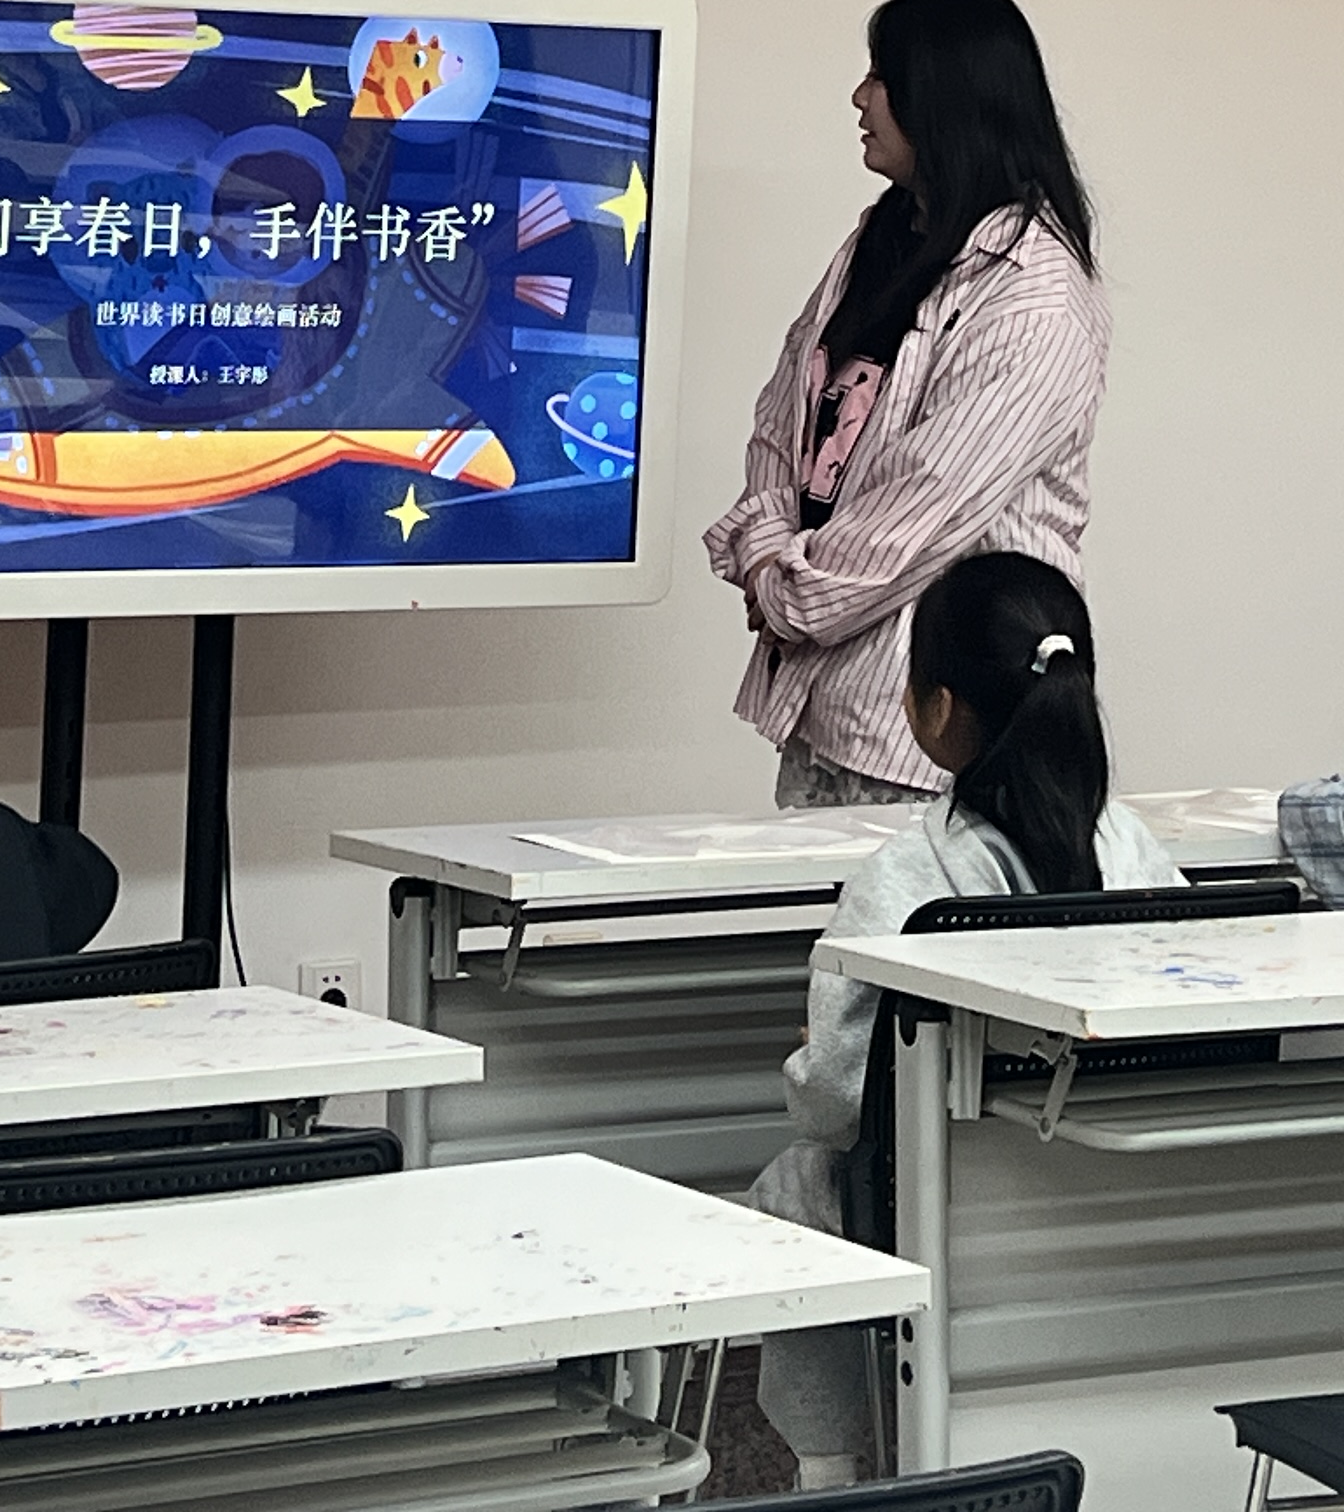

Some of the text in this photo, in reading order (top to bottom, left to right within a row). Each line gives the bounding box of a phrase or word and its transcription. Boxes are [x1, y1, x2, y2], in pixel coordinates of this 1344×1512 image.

[95, 299, 343, 328] 世界读书日创意绘画活动
